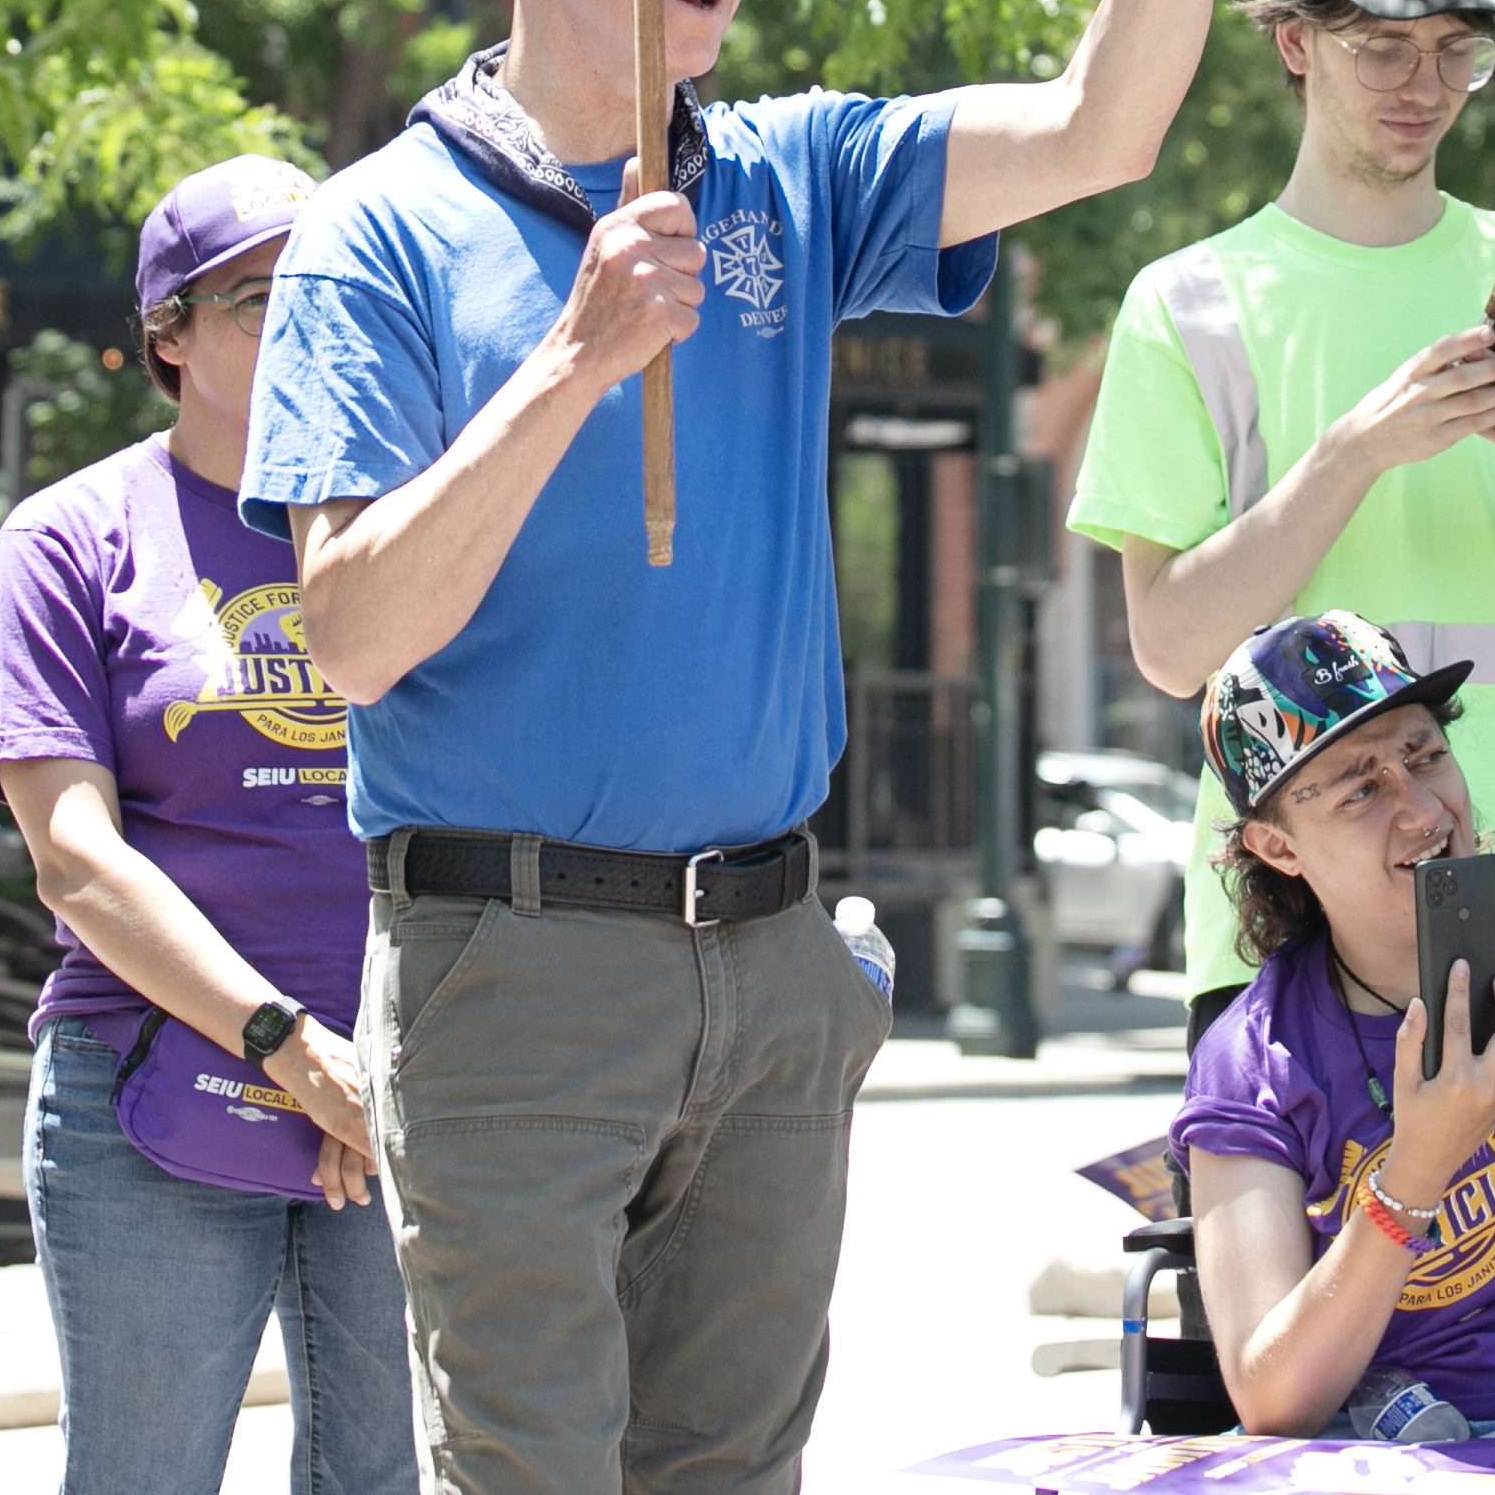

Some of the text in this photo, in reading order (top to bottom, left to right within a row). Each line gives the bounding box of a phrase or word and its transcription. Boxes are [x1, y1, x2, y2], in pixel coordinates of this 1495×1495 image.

[266, 592, 300, 606] FOR
[1314, 668, 1332, 685] B
[257, 714, 287, 738] PARA
[291, 730, 316, 743] LOS
[242, 767, 296, 788] SEIU
[194, 1073, 244, 1098] SEIU
[246, 1087, 288, 1106] LOCAL
[1399, 1292, 1432, 1306] PARA
[1437, 1282, 1463, 1300] LOS
